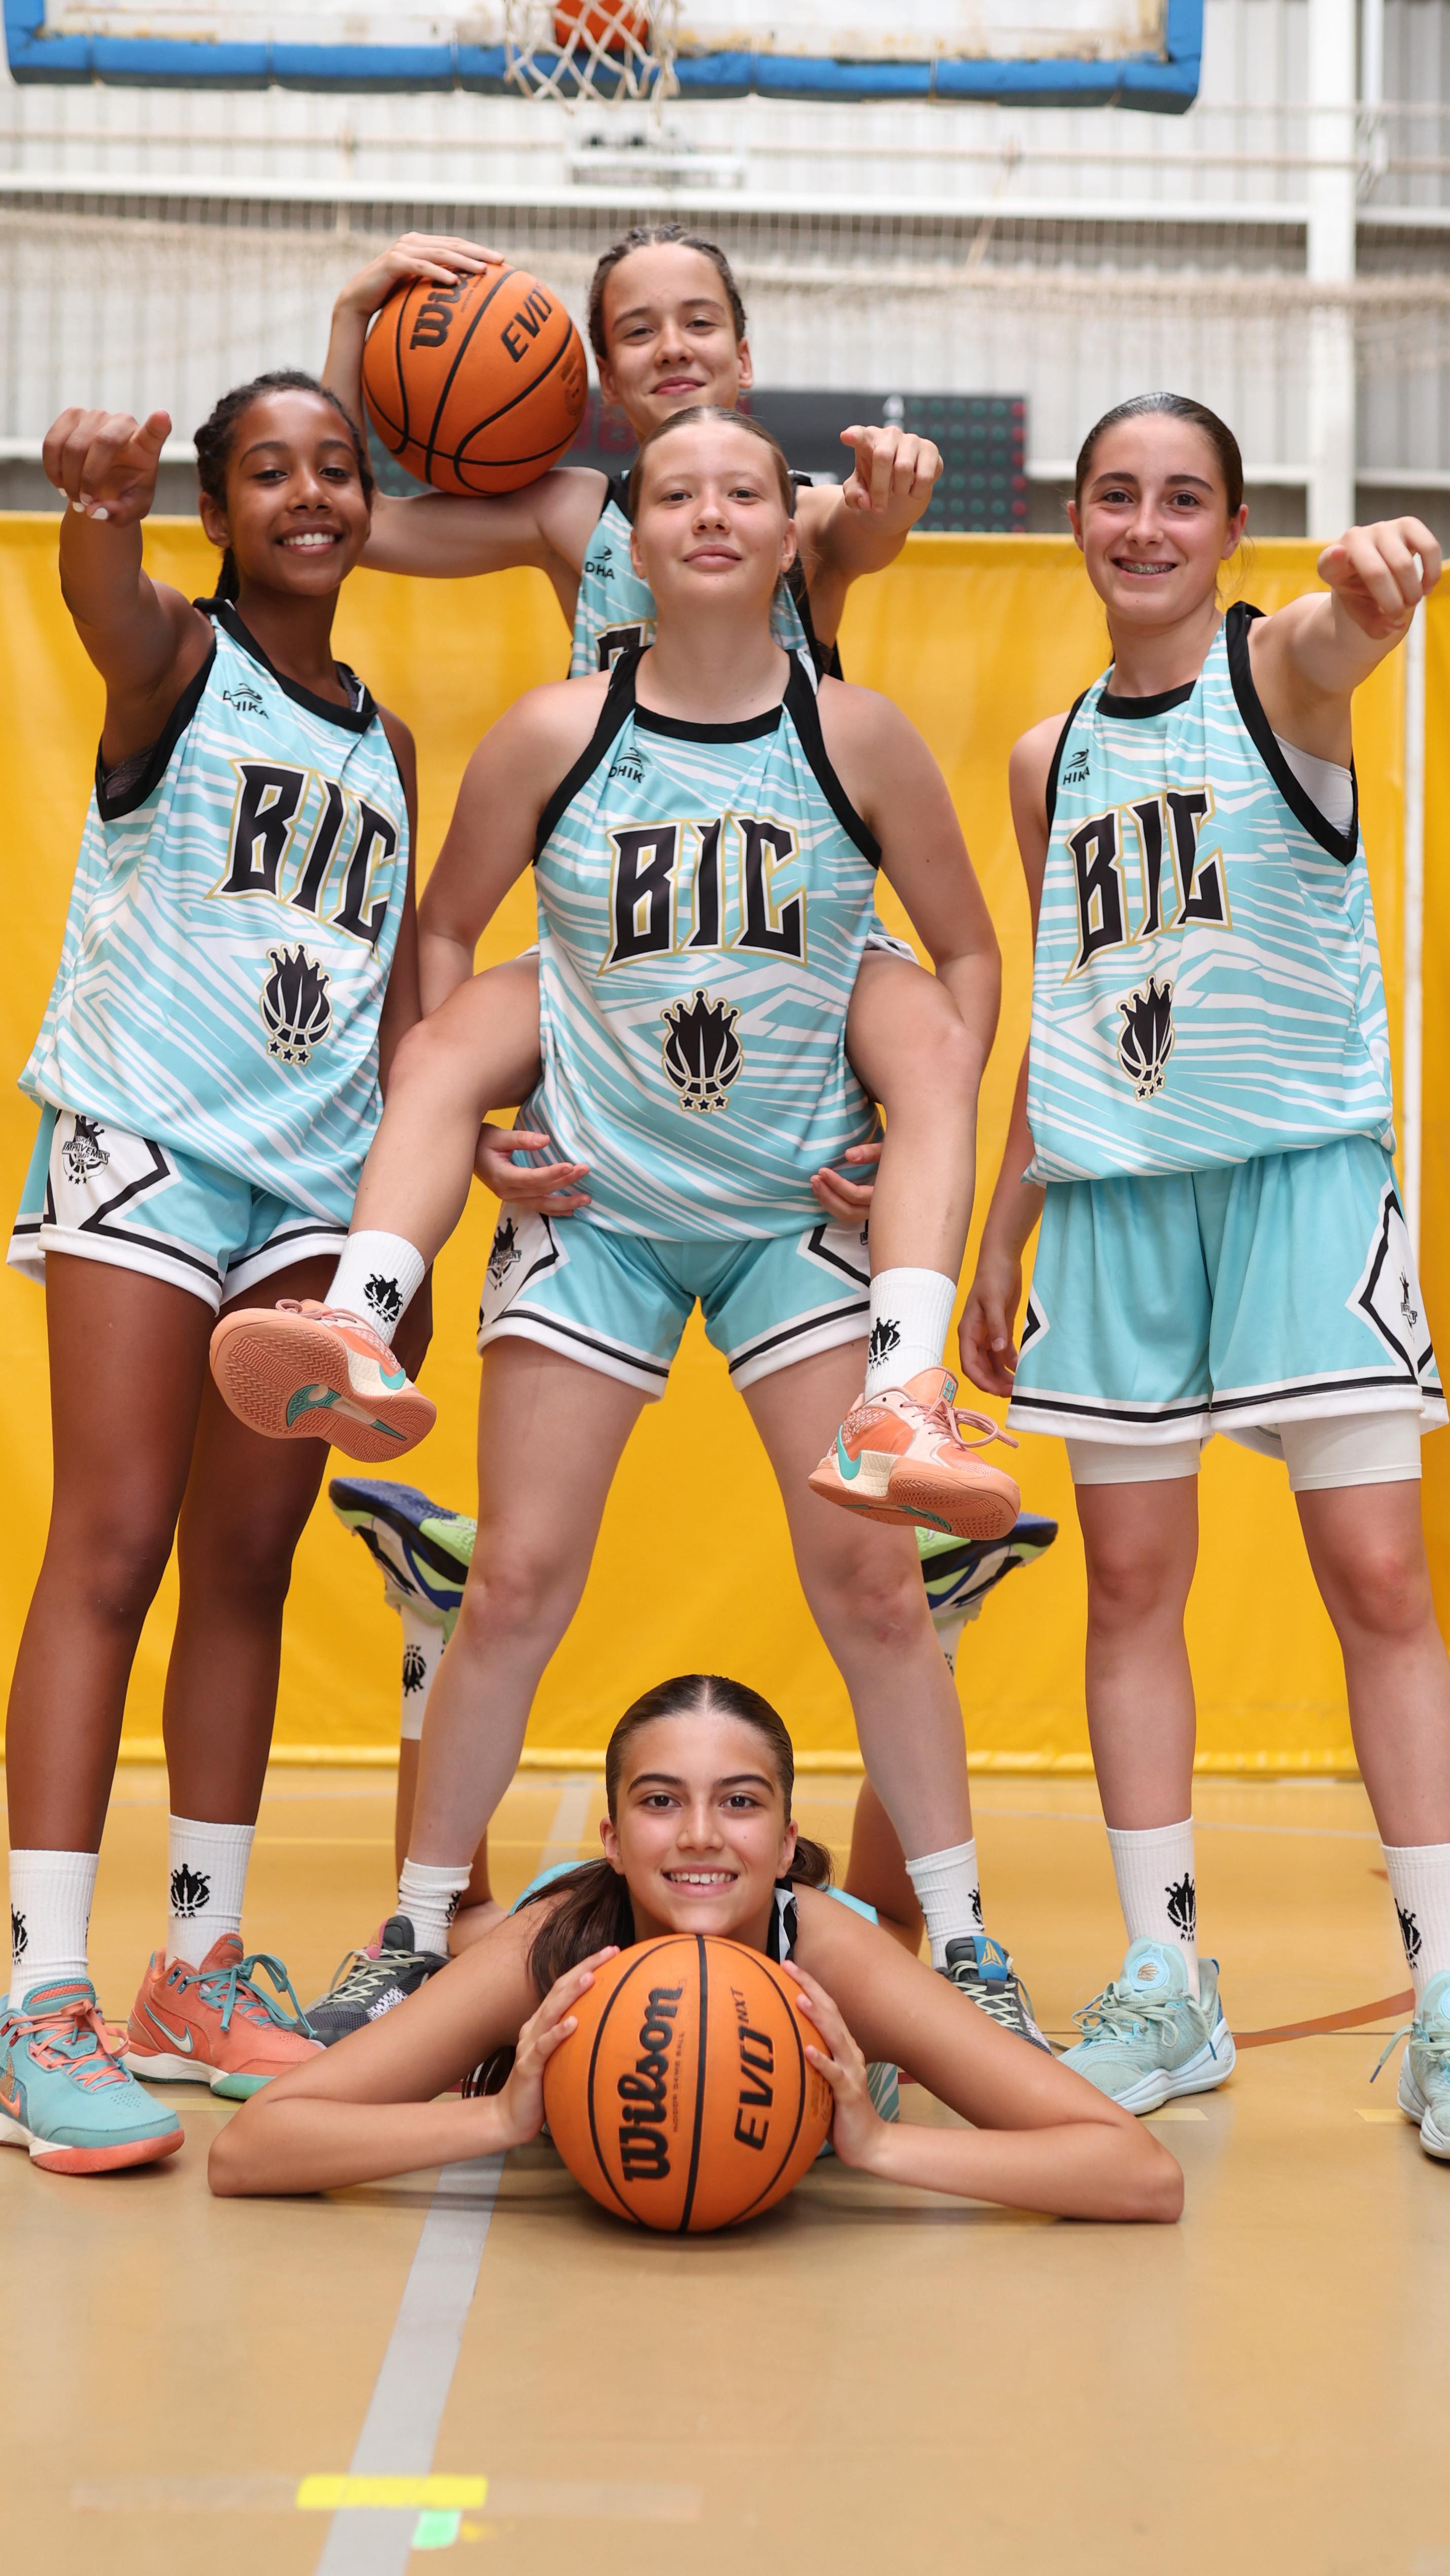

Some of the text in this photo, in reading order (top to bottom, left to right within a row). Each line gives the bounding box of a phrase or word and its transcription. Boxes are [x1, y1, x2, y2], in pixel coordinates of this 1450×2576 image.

[209, 761, 397, 957] BIC
[608, 765, 645, 783] DHIK
[601, 813, 806, 973] BIC
[1065, 786, 1231, 982] BIC
[618, 1986, 683, 2182] Wilson
[730, 1986, 749, 2023] NXT
